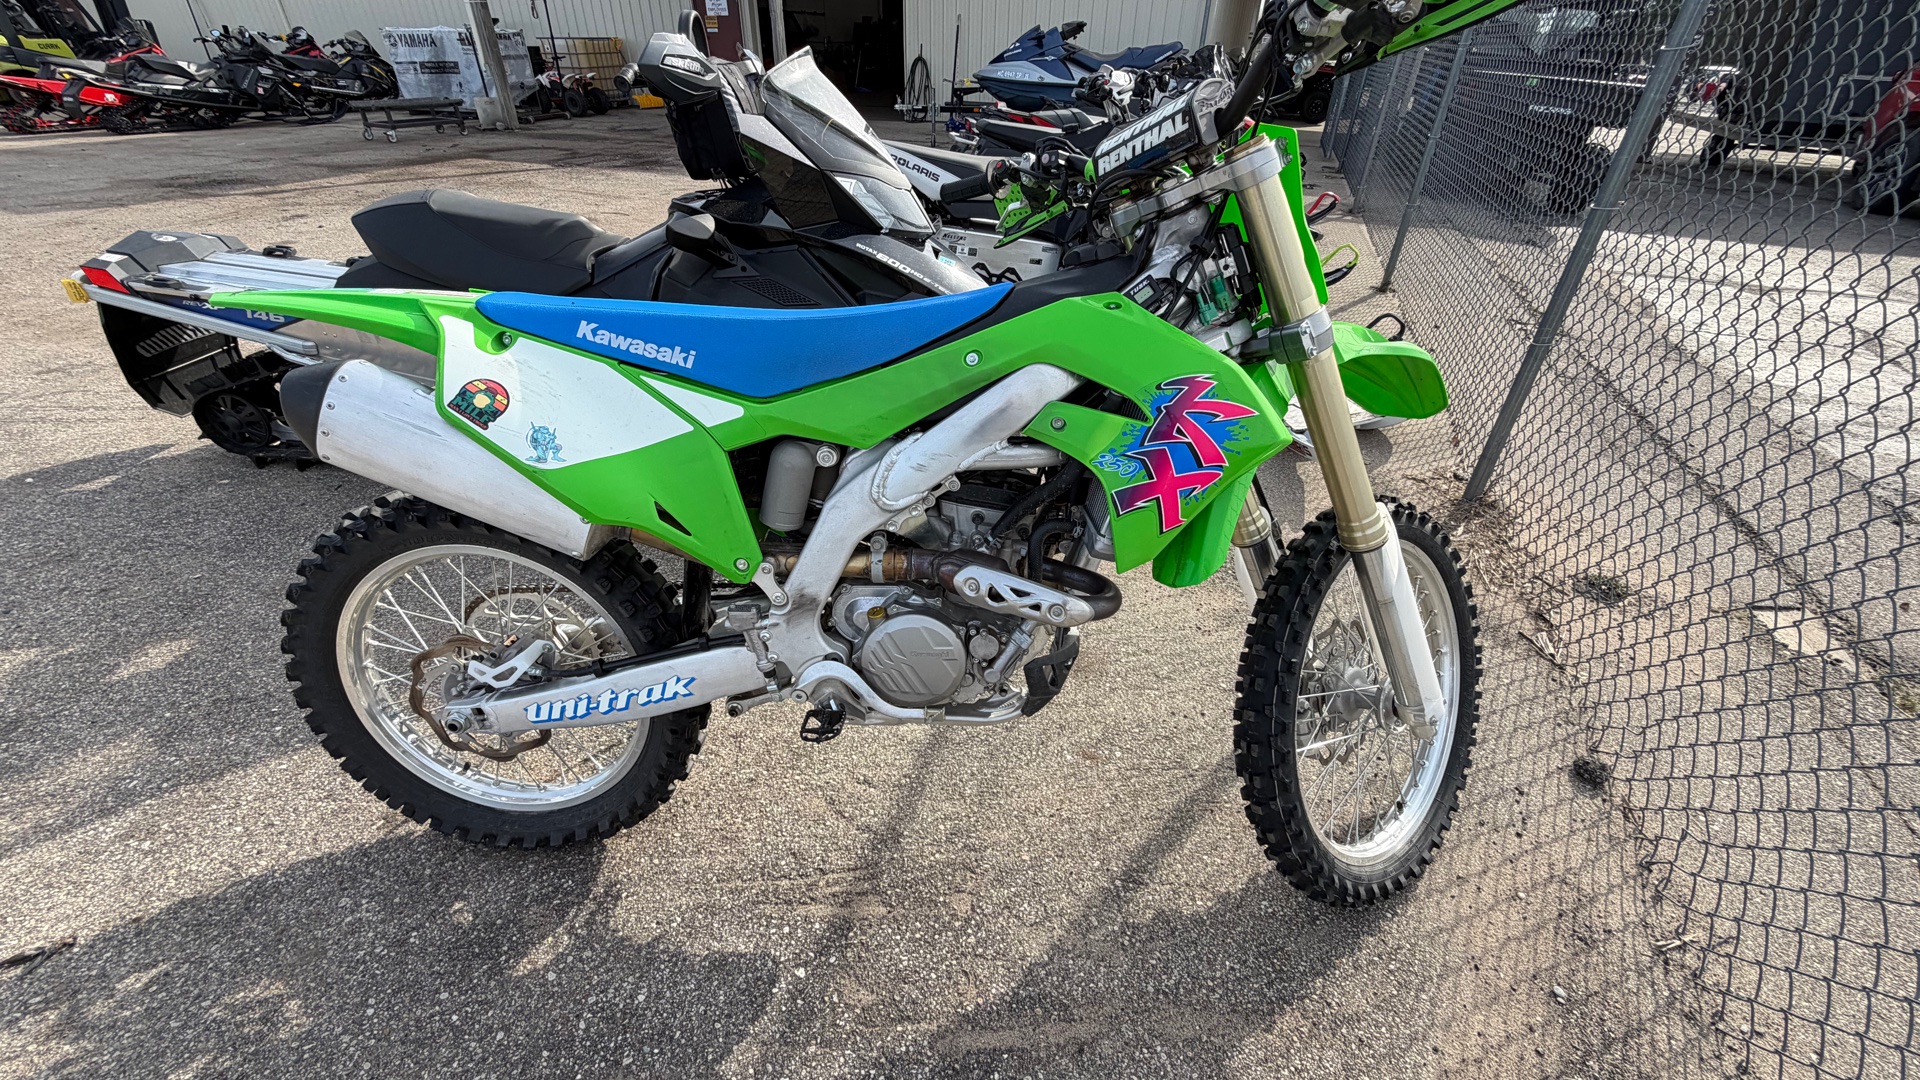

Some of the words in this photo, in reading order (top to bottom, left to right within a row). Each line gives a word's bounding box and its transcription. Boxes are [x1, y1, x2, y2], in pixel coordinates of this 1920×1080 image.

[397, 33, 437, 48] YAMAHA
[1098, 112, 1189, 176] RENTHAL
[890, 153, 941, 183] POLARIS
[856, 242, 877, 254] ROTAX
[876, 252, 912, 274] 600
[910, 270, 924, 281] HO
[246, 308, 285, 323] 146
[576, 319, 696, 370] Kawasaki
[452, 396, 495, 423] MILF
[1090, 452, 1140, 478] 250
[523, 674, 696, 725] uni-trak
